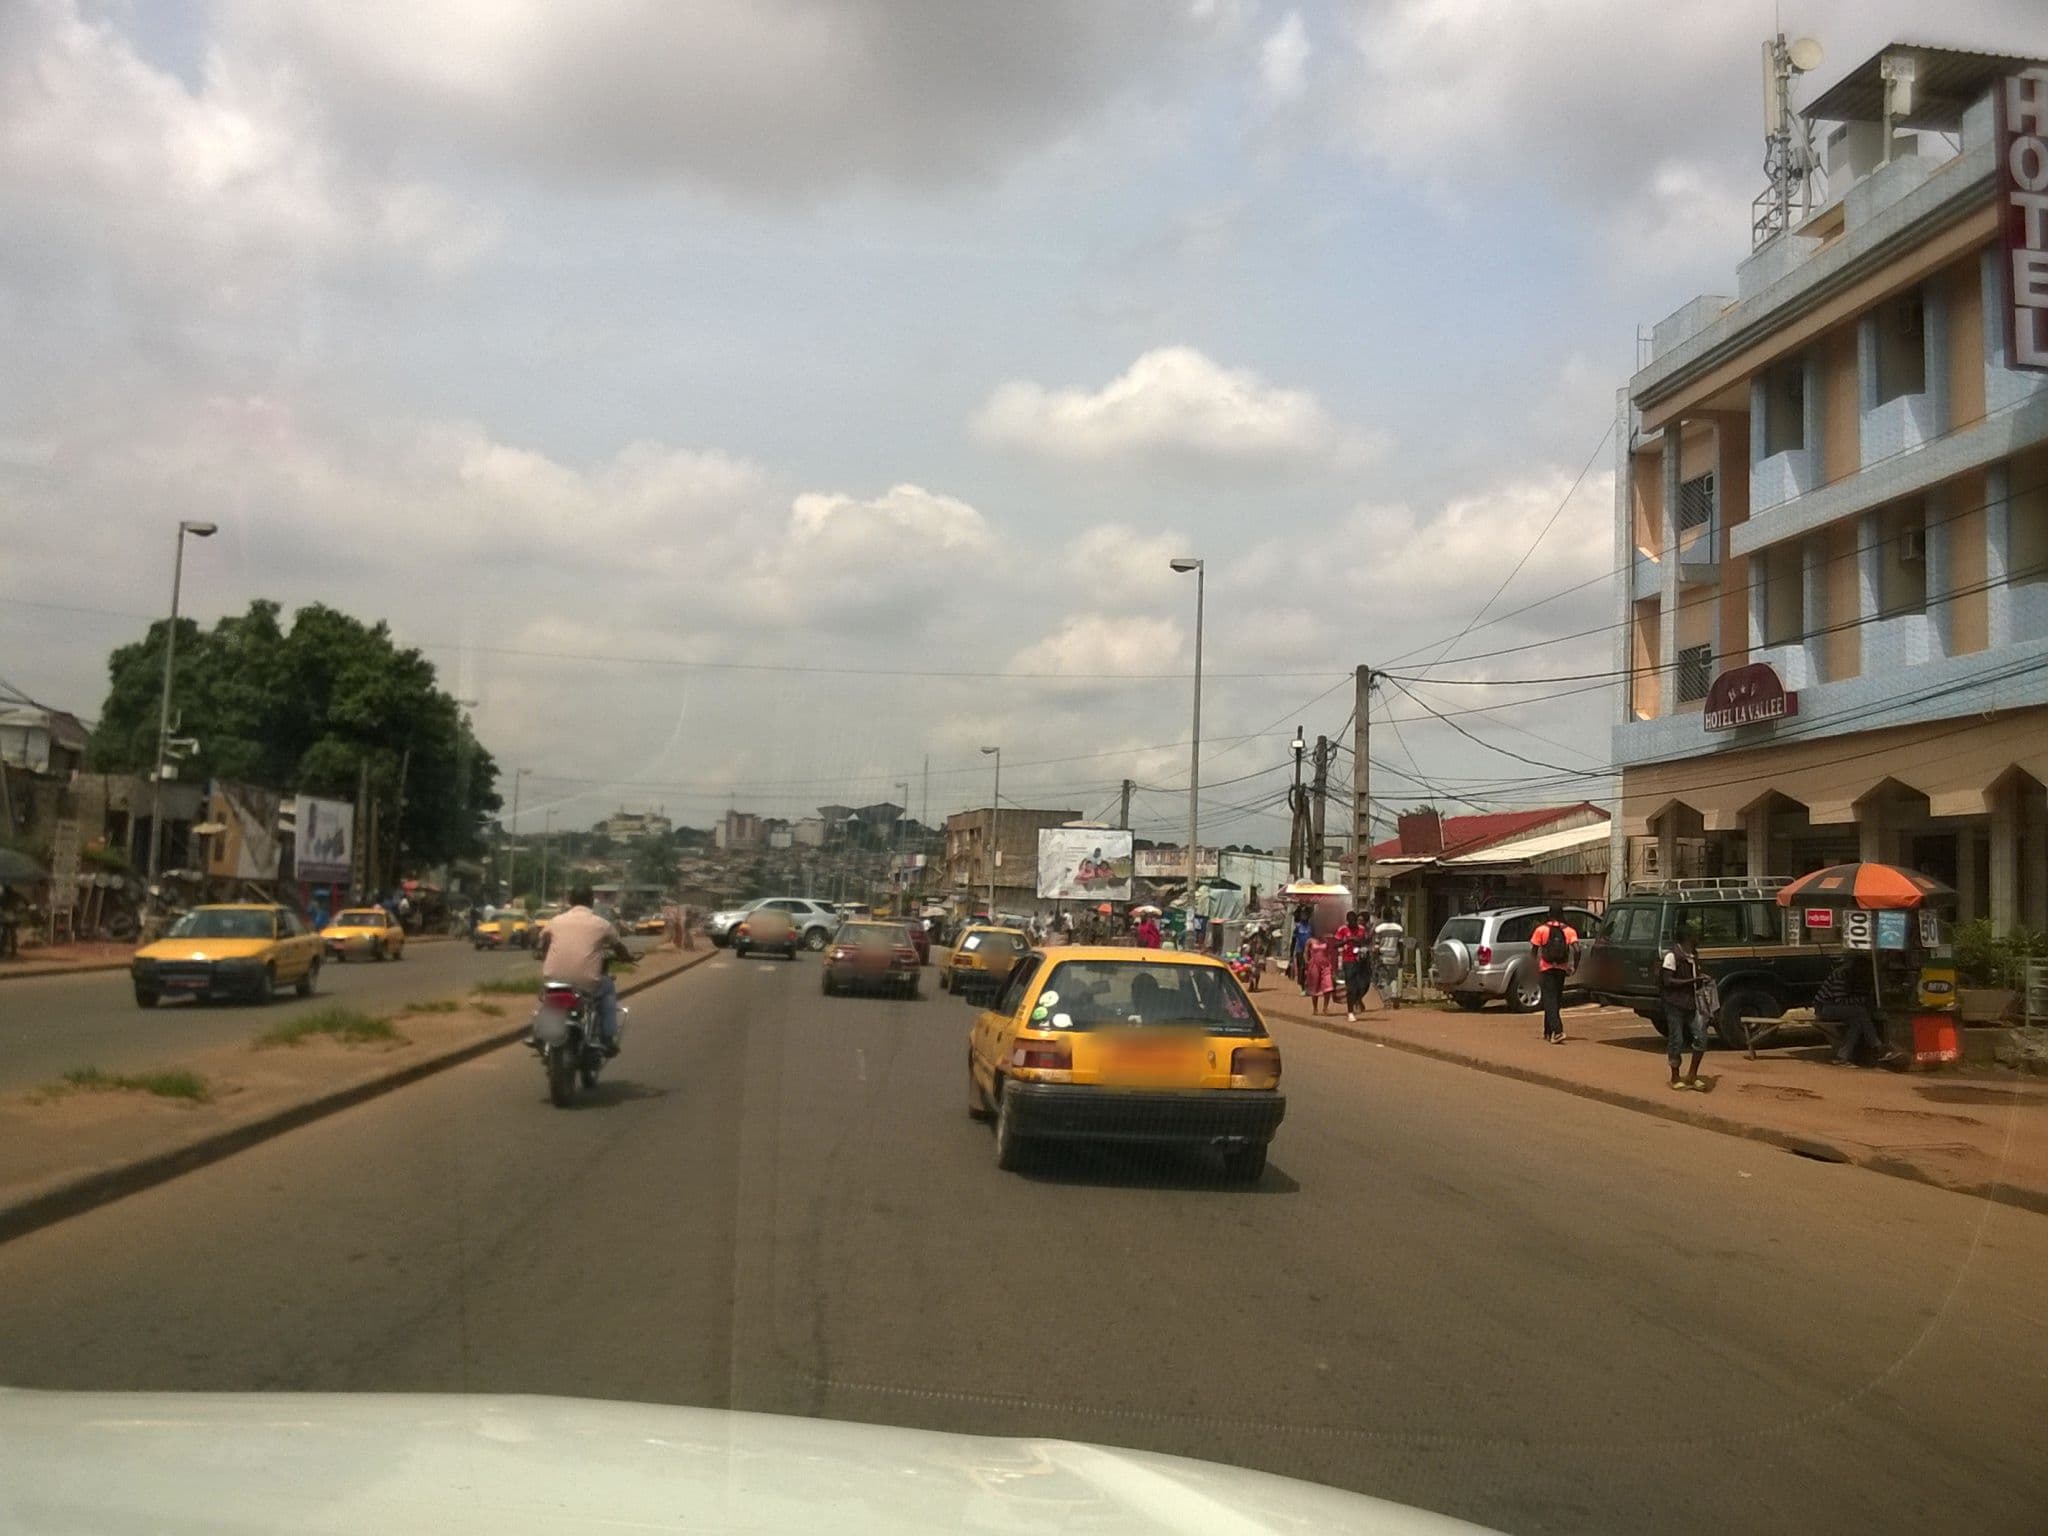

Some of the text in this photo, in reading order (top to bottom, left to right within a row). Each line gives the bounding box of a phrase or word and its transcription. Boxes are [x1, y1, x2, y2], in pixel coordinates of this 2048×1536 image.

[2006, 67, 2048, 366] HOTEL
[1705, 697, 1783, 730] HOTEL LA VALLEE
[1850, 912, 1868, 948] 100
[1921, 919, 1937, 942] 50
[1916, 1049, 1954, 1061] orange
